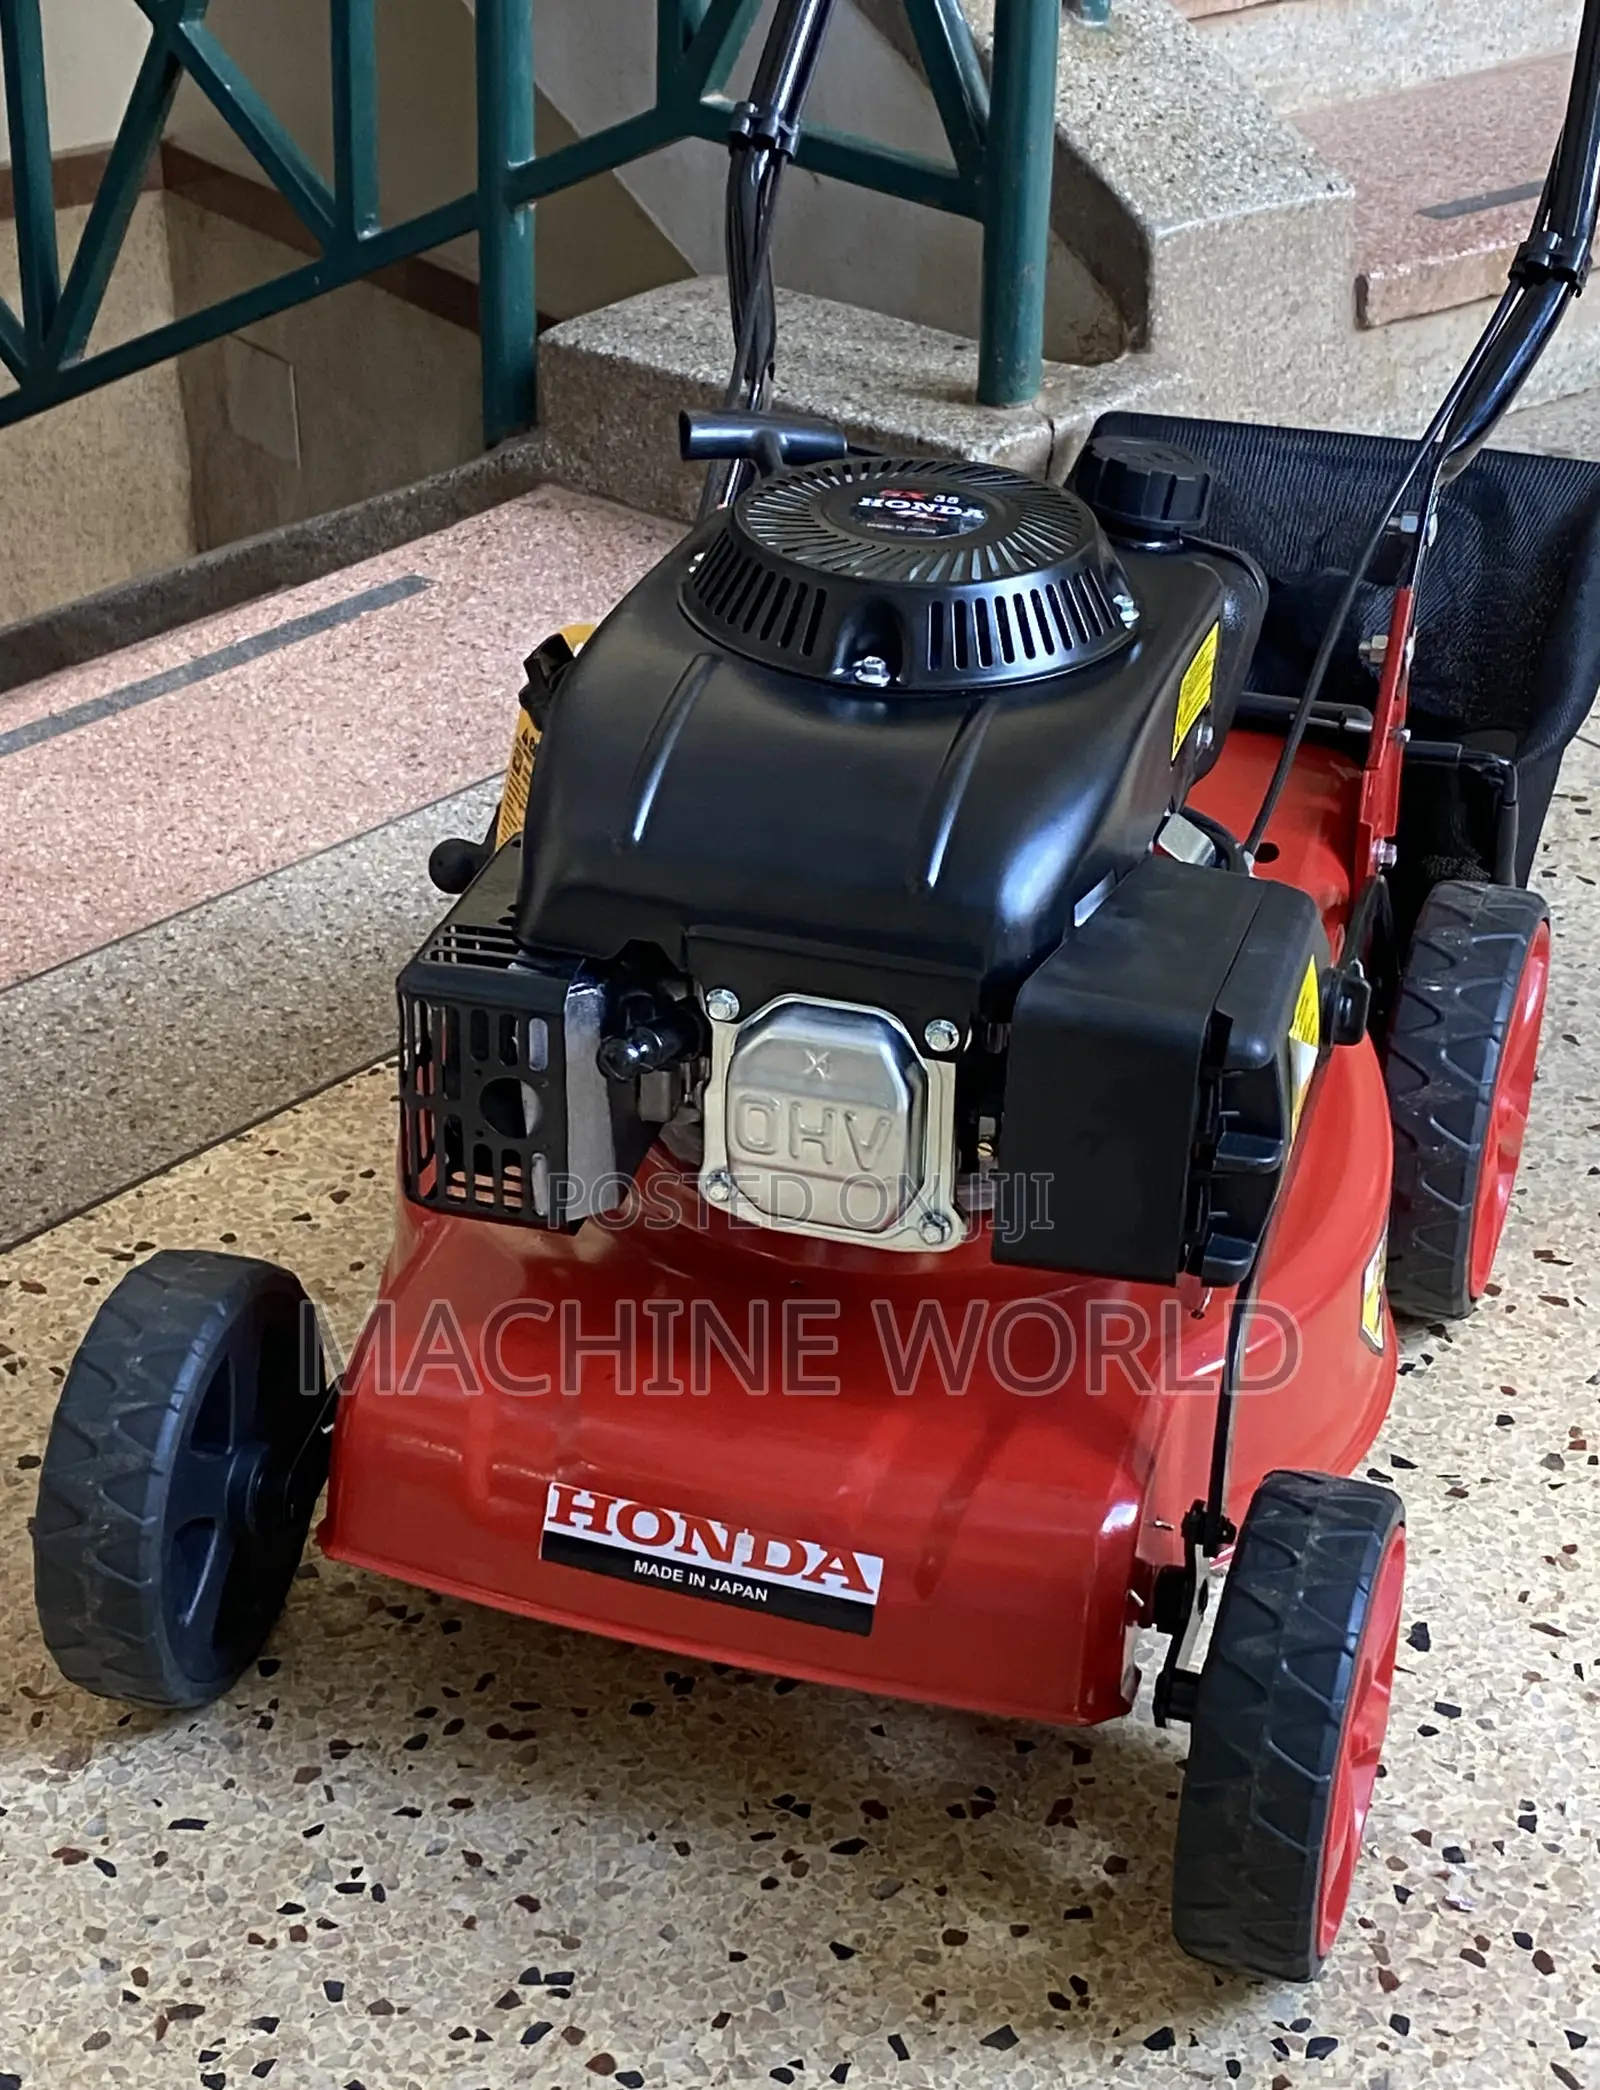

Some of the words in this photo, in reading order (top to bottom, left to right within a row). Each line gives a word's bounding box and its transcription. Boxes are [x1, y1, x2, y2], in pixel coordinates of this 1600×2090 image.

[858, 497, 986, 519] HONDA
[735, 1093, 894, 1171] OHV
[548, 1484, 875, 1595] HONDA
[633, 1560, 684, 1583] MADE
[688, 1572, 706, 1589] IN
[709, 1578, 768, 1602] JAPAN
